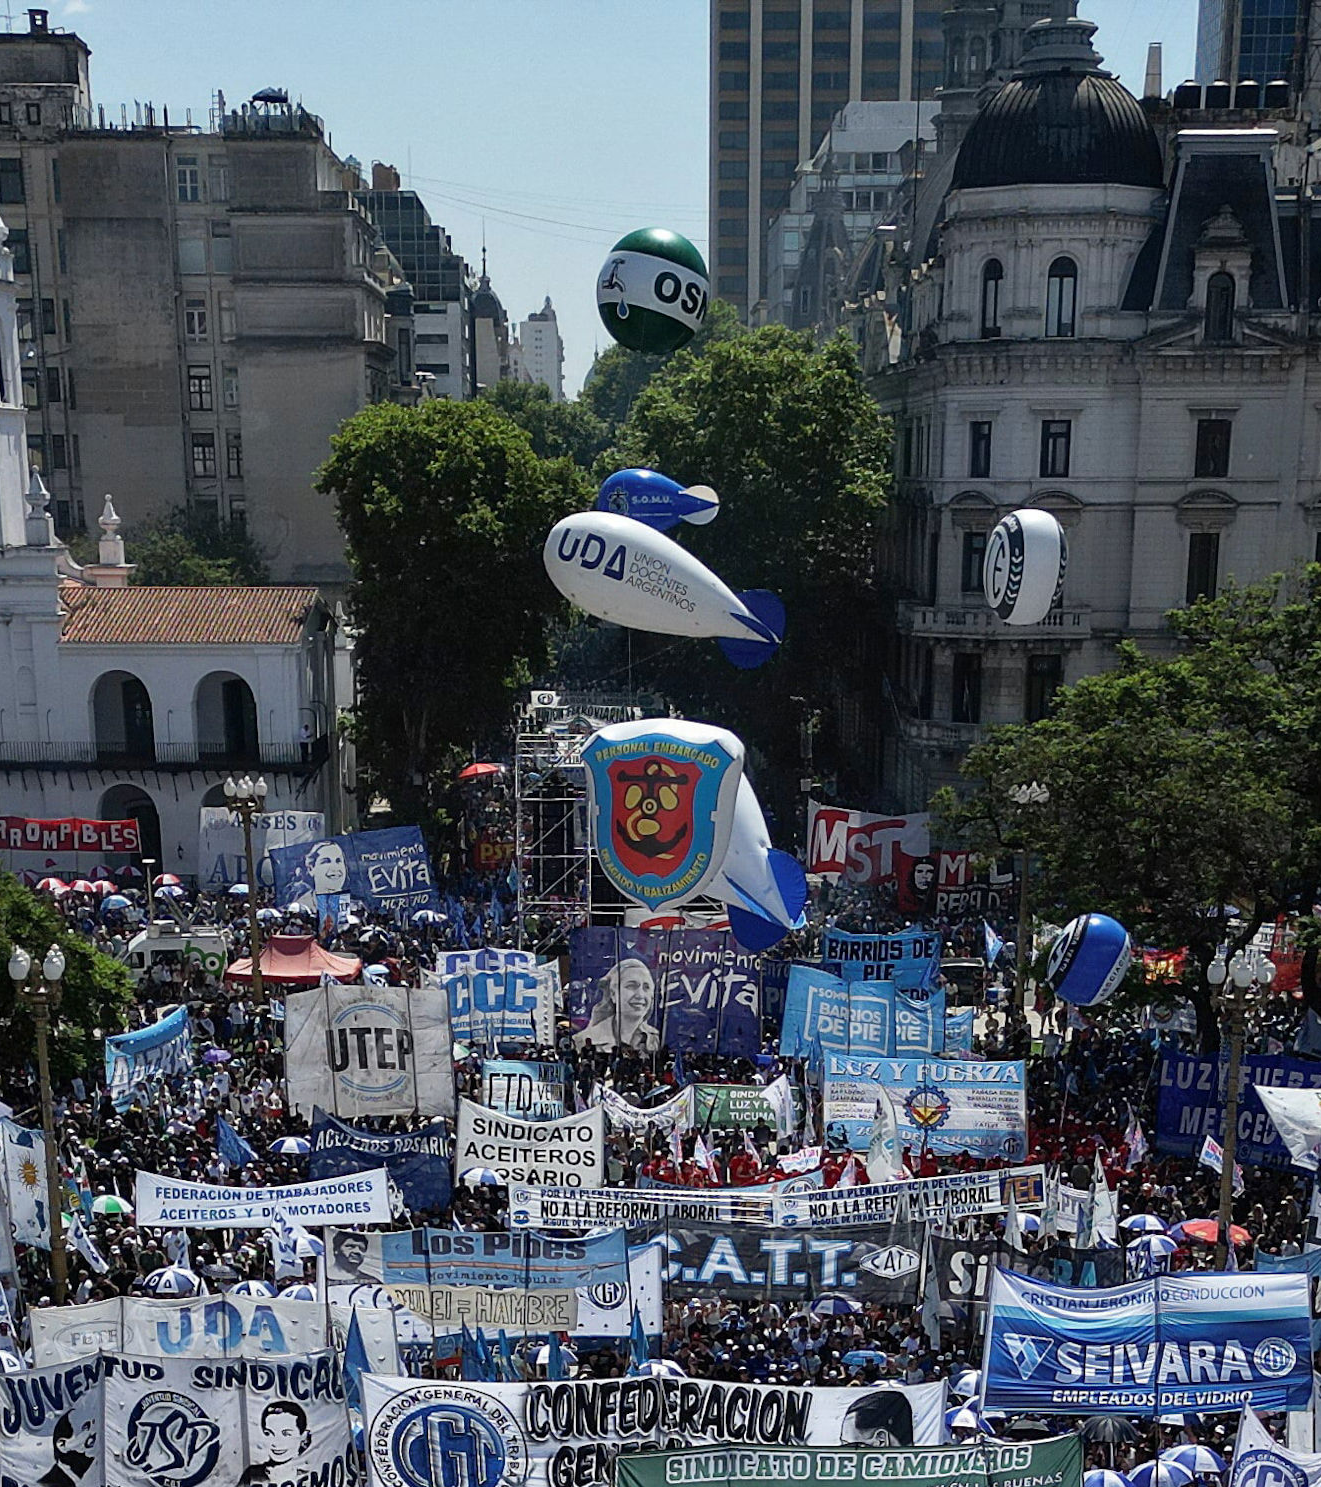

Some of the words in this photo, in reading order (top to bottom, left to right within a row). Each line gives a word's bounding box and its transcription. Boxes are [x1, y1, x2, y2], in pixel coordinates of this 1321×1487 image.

[558, 528, 626, 580] UDA
[635, 551, 670, 574] UNION
[630, 564, 688, 595] DOCENTES
[625, 576, 696, 613] ARGENTINOS
[595, 743, 650, 762] PERSONAL
[653, 742, 720, 769] EMBARCADO
[813, 815, 907, 883] MST
[644, 852, 707, 897] BALIZAMIENTO
[828, 939, 903, 960] BARRIOS
[913, 937, 935, 959] DE
[450, 972, 537, 1016] CCC
[660, 970, 759, 1012] Evita
[819, 1003, 881, 1023] BARRIOS
[818, 1017, 844, 1037] DE
[849, 1021, 881, 1042] PIE
[326, 1027, 413, 1072] UTEP
[831, 1057, 880, 1079] LUZ
[887, 1063, 908, 1082] Y
[917, 1062, 1020, 1084] FUERZA
[473, 1118, 593, 1142] SINDICATO
[464, 1142, 596, 1167] ACEITEROS
[156, 1184, 242, 1200] FEDERACIÓN
[247, 1186, 264, 1199] DE
[268, 1180, 373, 1200] TRABAJADORES
[161, 1205, 237, 1219] ACEITEROS
[244, 1206, 254, 1218] Y
[541, 1202, 559, 1217] NO
[576, 1202, 589, 1217] LA
[594, 1203, 659, 1219] REFORMA
[809, 1203, 827, 1218] NO
[844, 1200, 857, 1216] LA
[412, 1231, 474, 1256] Los
[483, 1232, 587, 1260] Pibes
[430, 1270, 508, 1283] Movimiento
[395, 1290, 452, 1320] MILEI
[478, 1290, 569, 1325] HAMBRE
[1021, 1292, 1093, 1308] CRISTIAN
[1172, 1285, 1265, 1300] CONDUCCIÓN
[1056, 1339, 1253, 1385] SEIVARA
[2, 1356, 164, 1436] JUVENTUD
[192, 1355, 345, 1401] SINDICAL
[1053, 1390, 1156, 1406] EMPLEADOS
[1160, 1390, 1190, 1405] DEL
[1194, 1391, 1253, 1405] VIDRIO
[423, 1389, 489, 1413] GENERAL
[491, 1406, 512, 1434] DEL
[527, 1384, 810, 1445] CONFEDERACION
[665, 1452, 809, 1485] SINDICATO
[815, 1453, 857, 1482] DE
[862, 1445, 1032, 1481] CAMIONEROS
